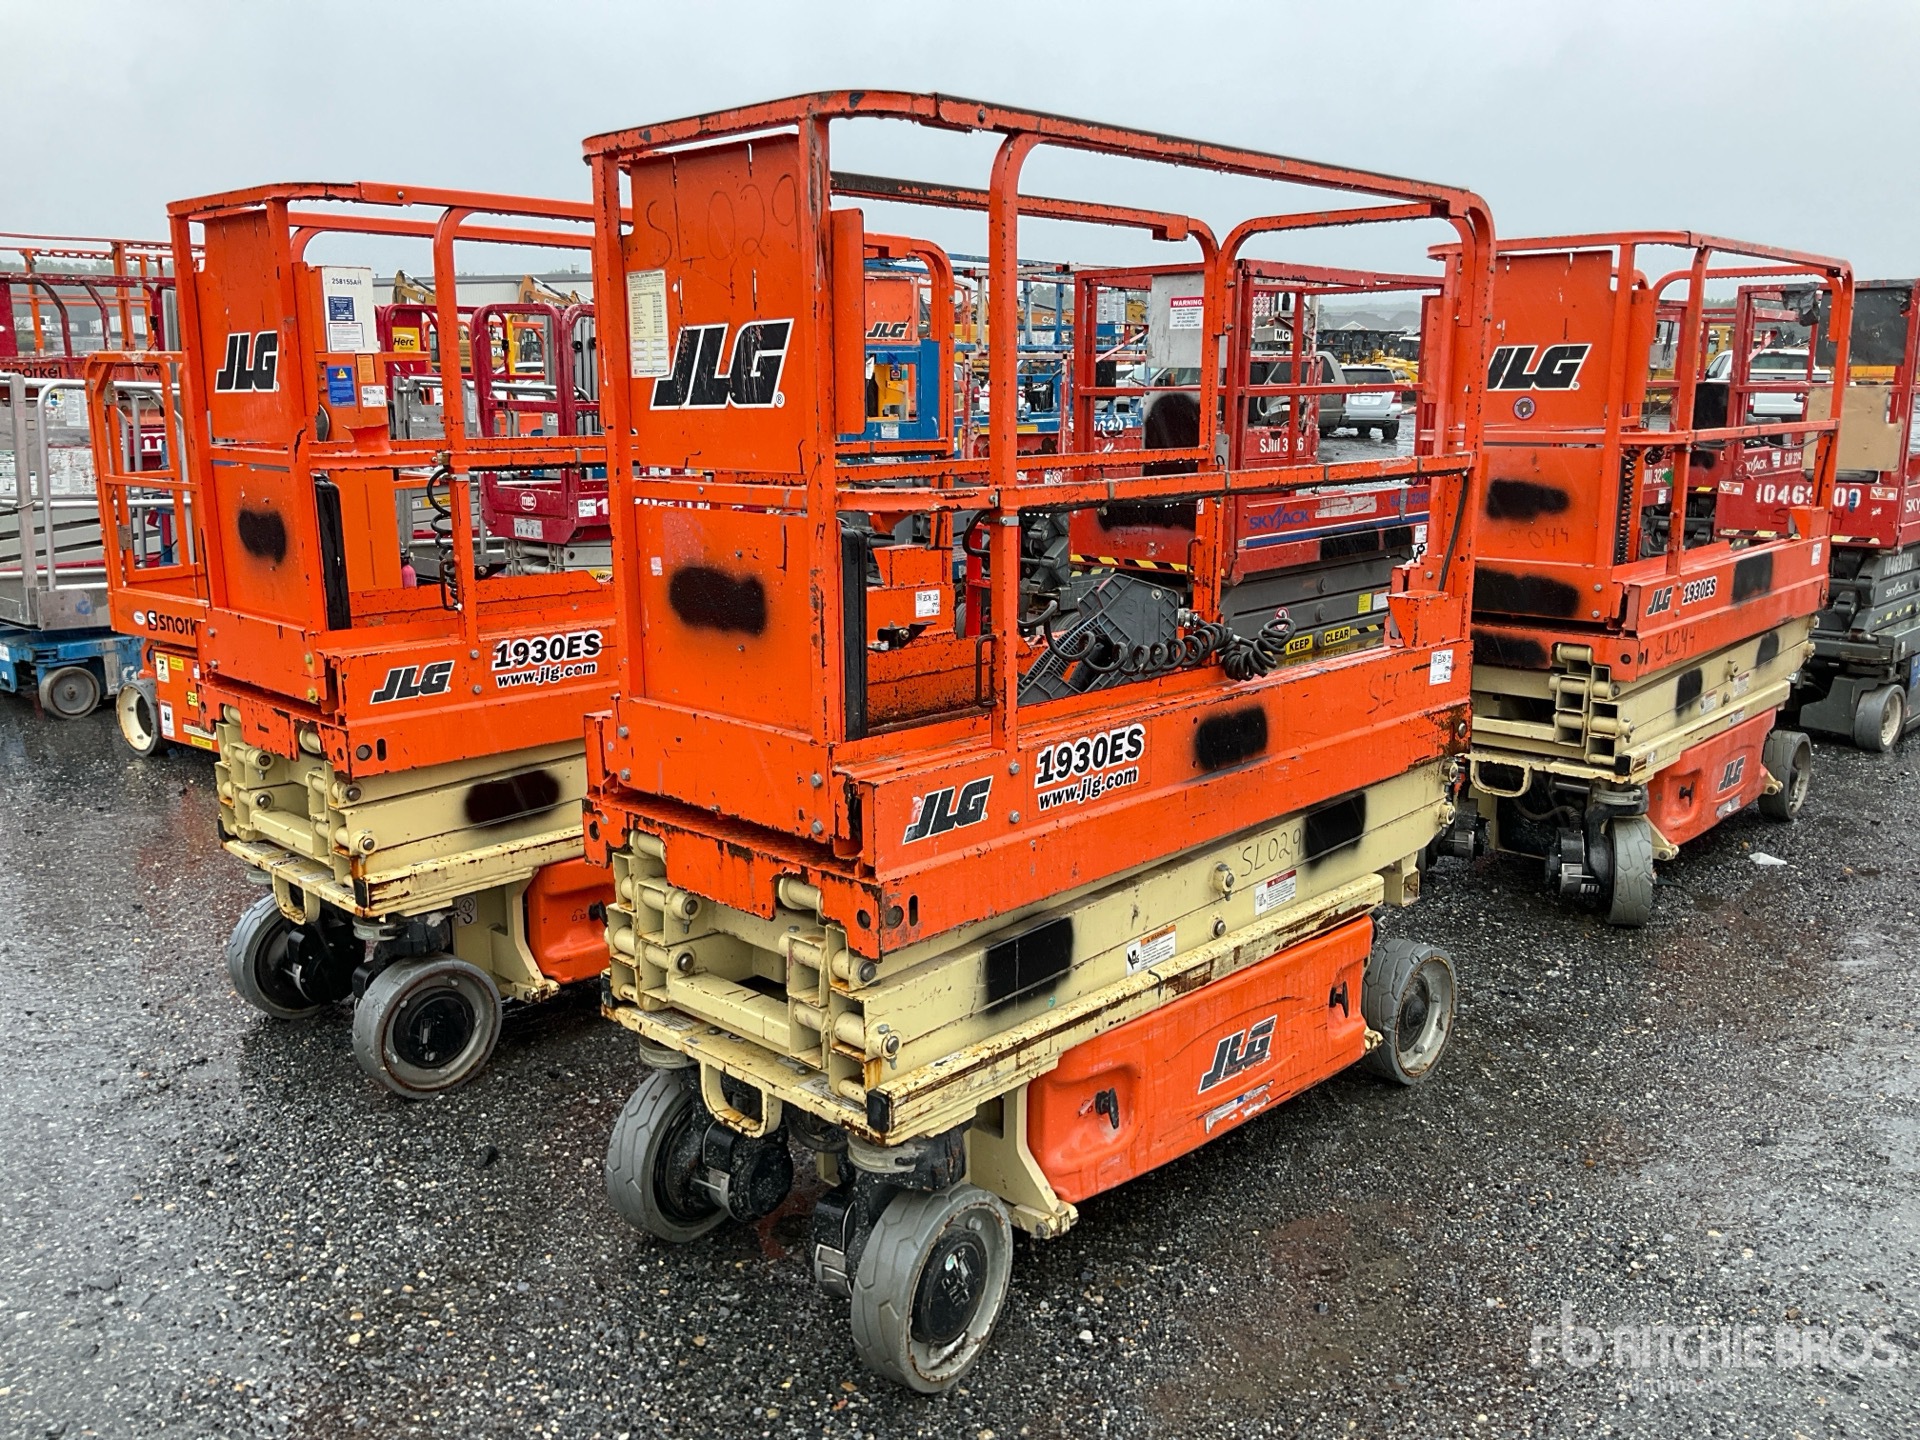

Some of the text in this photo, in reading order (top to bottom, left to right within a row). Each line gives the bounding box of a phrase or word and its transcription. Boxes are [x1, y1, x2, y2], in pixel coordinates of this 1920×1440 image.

[1172, 299, 1203, 307] WARNING
[393, 337, 414, 346] Herc
[865, 321, 909, 339] JLG
[1275, 329, 1290, 341] MC
[215, 331, 278, 393] JLG
[650, 318, 794, 410] JLG
[1486, 343, 1592, 391] JLG
[1250, 506, 1310, 530] SKYJACK
[1646, 576, 1717, 617] JLG 1930ES
[1289, 638, 1310, 652] KEEP
[1325, 629, 1349, 644] CLEAR
[370, 629, 603, 704] JLG 1930ES
[496, 660, 598, 689] www.jlg.com
[902, 723, 1146, 845] JLG 1930ES
[1038, 766, 1140, 811] www.jlg.com
[1717, 754, 1747, 793] JLG
[1198, 1014, 1278, 1095] JLG
